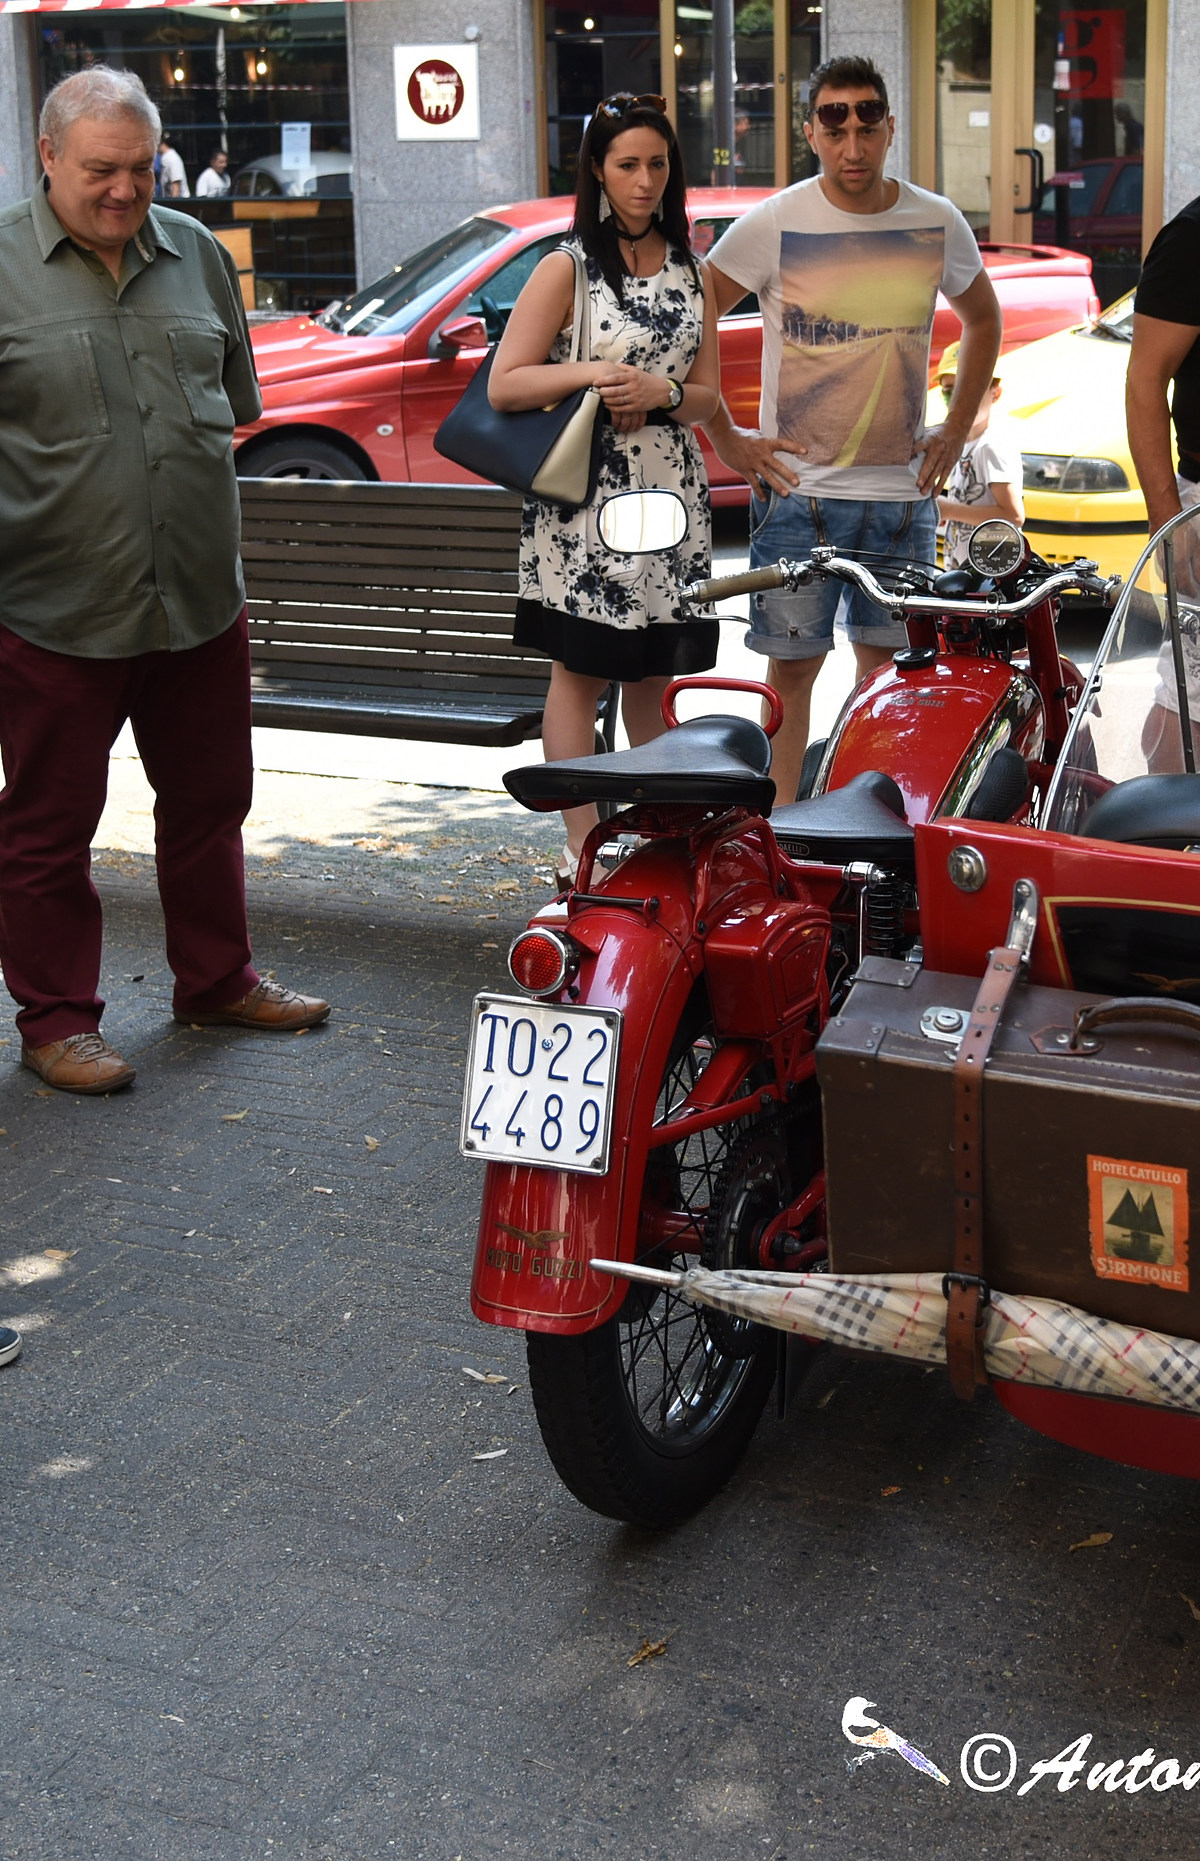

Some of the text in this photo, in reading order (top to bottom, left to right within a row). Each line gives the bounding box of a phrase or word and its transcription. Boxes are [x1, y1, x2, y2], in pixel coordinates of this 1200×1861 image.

[481, 1013, 608, 1087] TO 22
[471, 1084, 600, 1154] 4489
[1093, 1160, 1182, 1185] HOTEL CATULLO
[487, 1248, 583, 1279] MOTO GUZZI
[1096, 1257, 1183, 1285] SIRMIONE
